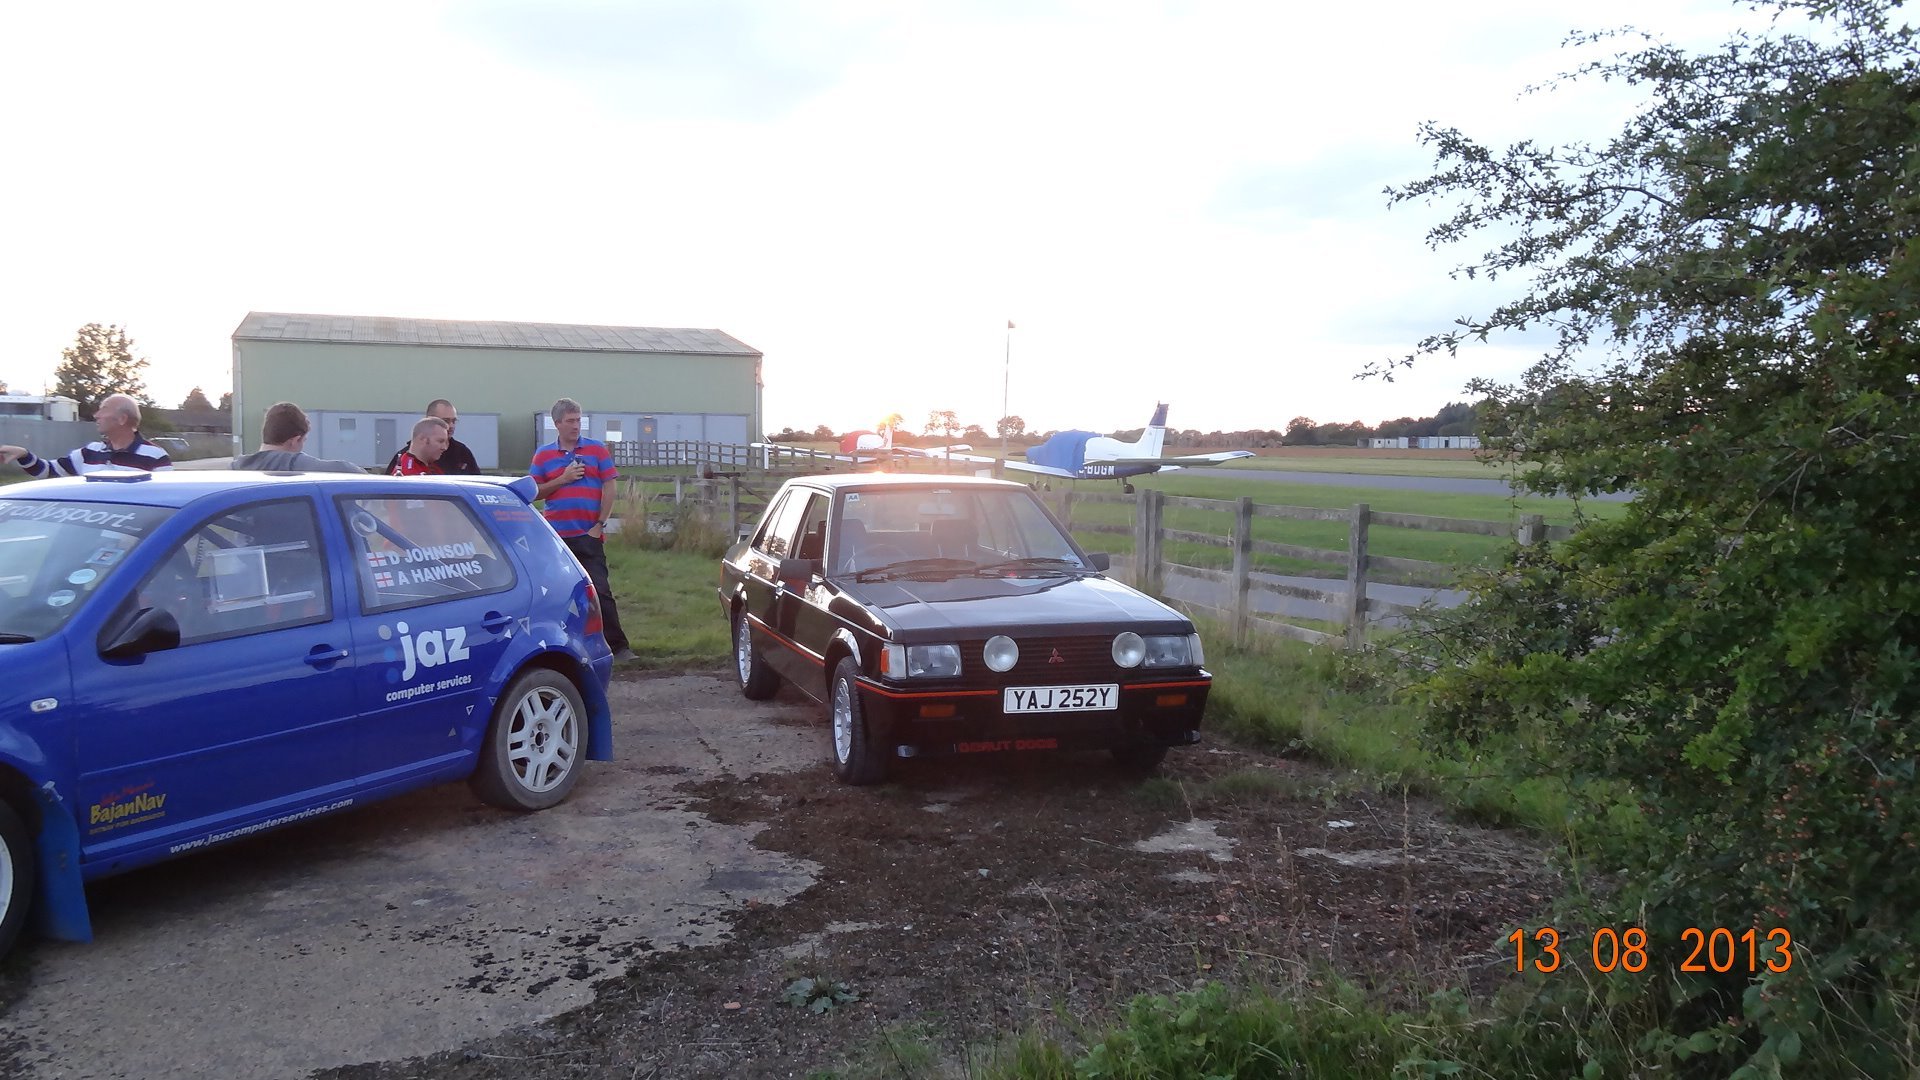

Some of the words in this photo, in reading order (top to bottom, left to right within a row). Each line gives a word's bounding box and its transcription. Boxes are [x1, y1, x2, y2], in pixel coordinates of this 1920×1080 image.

[386, 551, 400, 565] D
[404, 542, 477, 563] JOHNSON
[398, 571, 410, 586] A
[411, 560, 483, 583] HAWKINS
[396, 621, 470, 682] jaz
[386, 683, 435, 702] computer
[436, 674, 472, 690] services
[1013, 689, 1053, 710] YAJ
[1058, 687, 1111, 708] 252Y
[90, 792, 167, 825] BajanNav
[170, 798, 354, 854] www.jazcomputerservices.com
